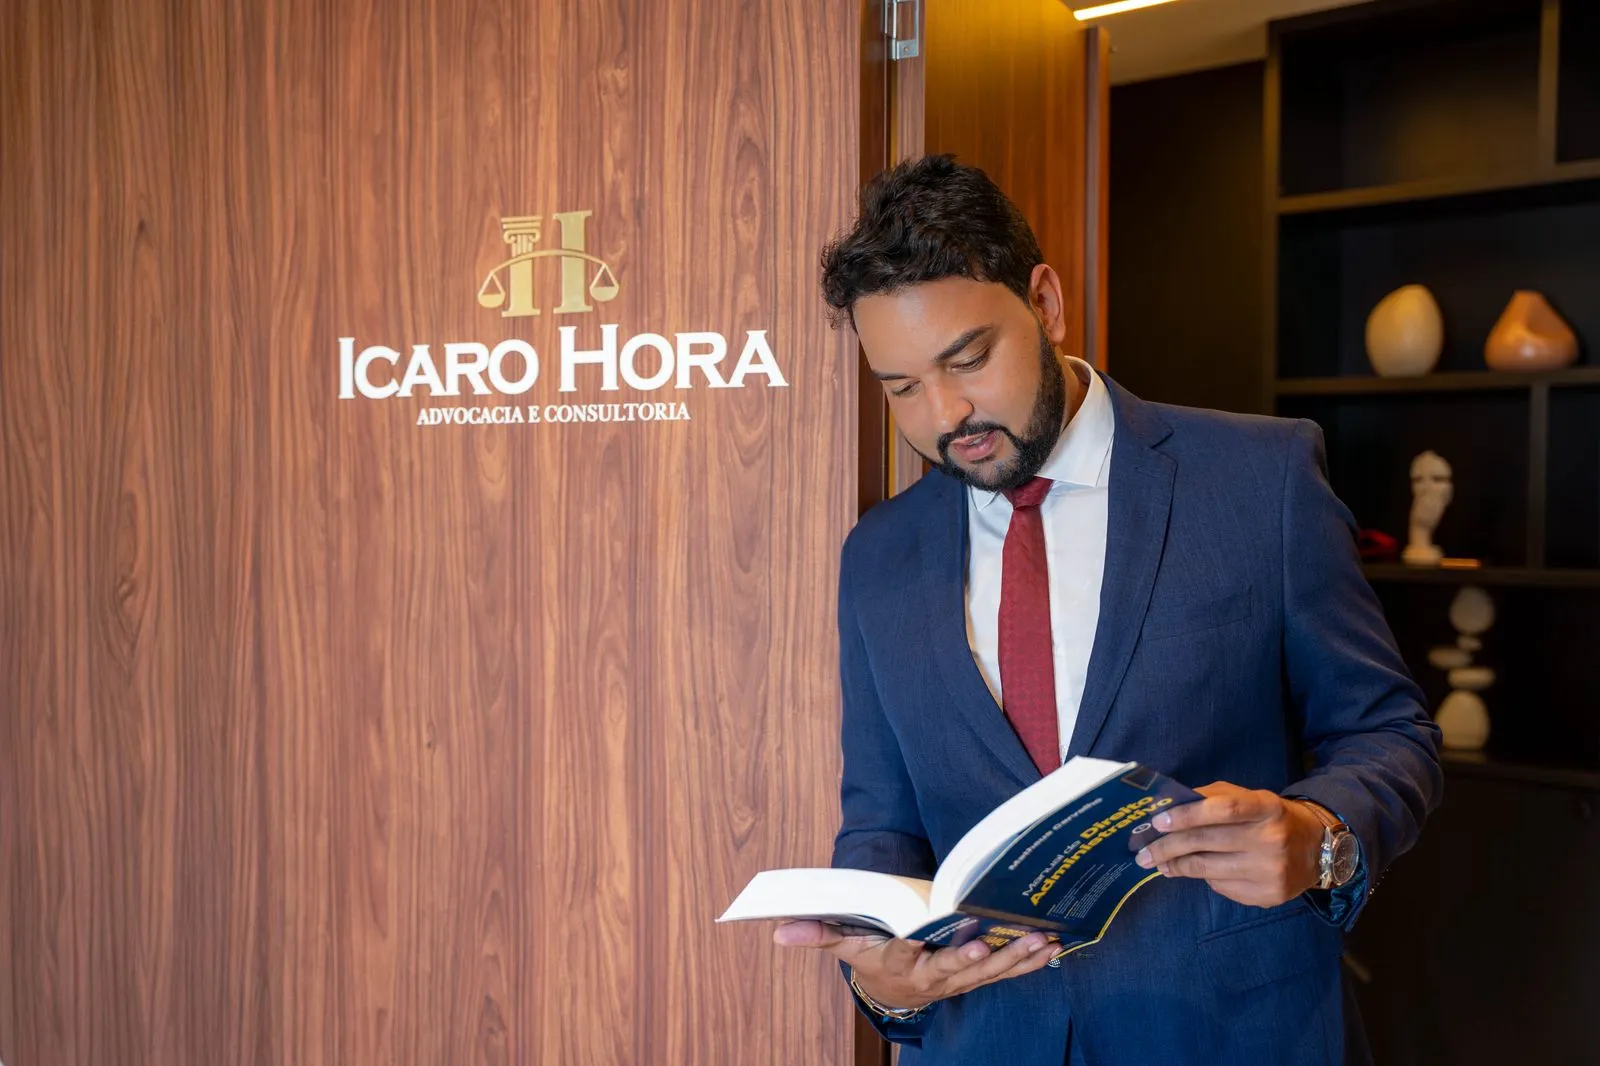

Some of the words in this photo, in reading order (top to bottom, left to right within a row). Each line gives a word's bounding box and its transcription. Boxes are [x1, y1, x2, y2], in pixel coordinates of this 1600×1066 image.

[338, 337, 539, 399] ICARO
[559, 324, 789, 392] HORA
[416, 405, 524, 426] ADVOCACIA
[528, 404, 540, 423] E
[544, 402, 691, 422] CONSULTORIA
[1022, 854, 1064, 896] Manual
[1064, 840, 1081, 854] de
[1080, 797, 1154, 839] Direito
[1030, 798, 1173, 906] Administrativo
